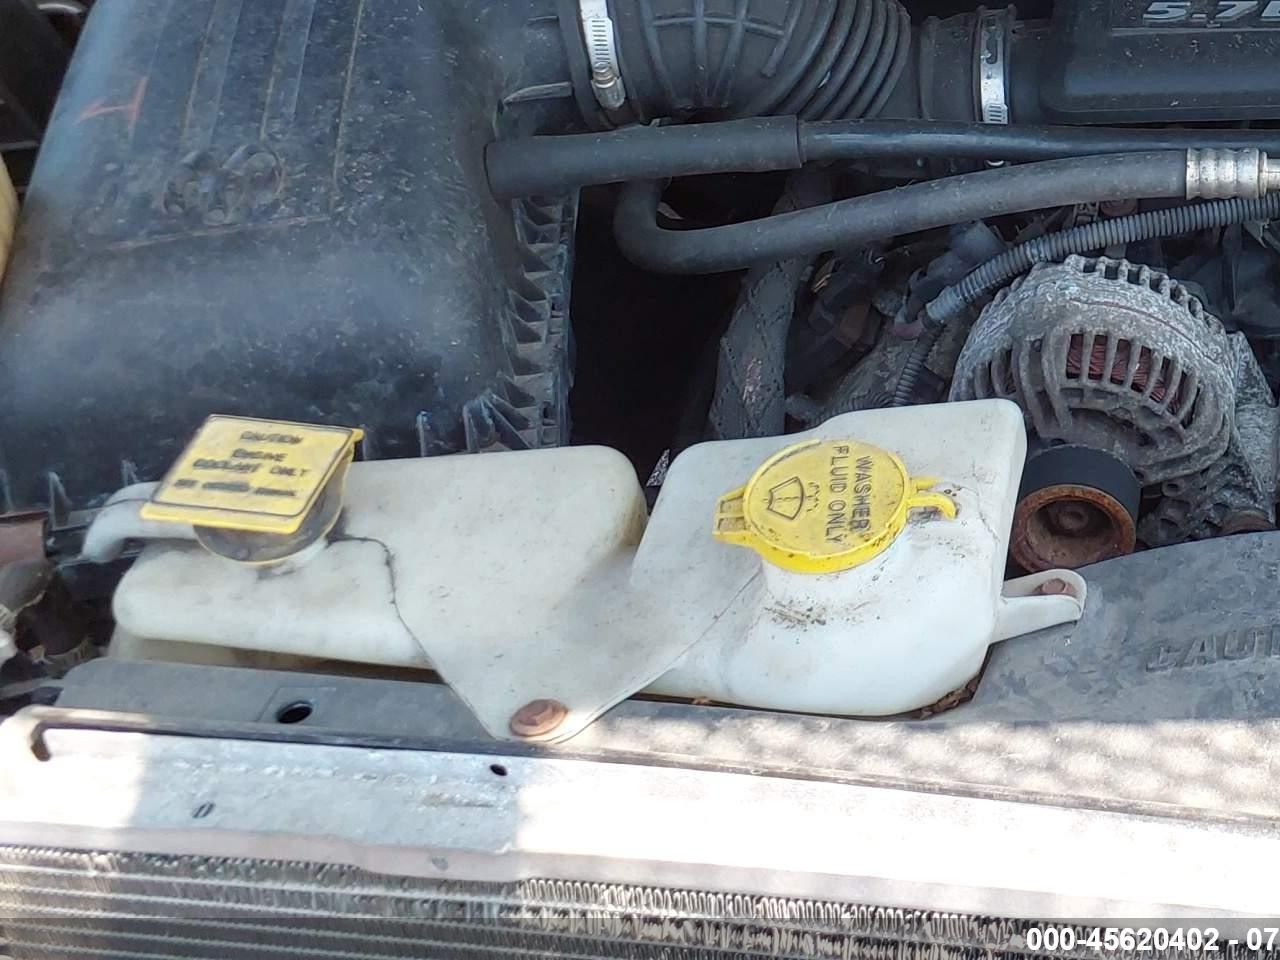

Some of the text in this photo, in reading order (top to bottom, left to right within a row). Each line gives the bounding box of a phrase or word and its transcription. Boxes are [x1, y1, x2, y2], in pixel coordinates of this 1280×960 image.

[240, 431, 304, 444] CAUTION
[826, 445, 850, 544] FLUID ONLY
[850, 456, 874, 532] WASHER
